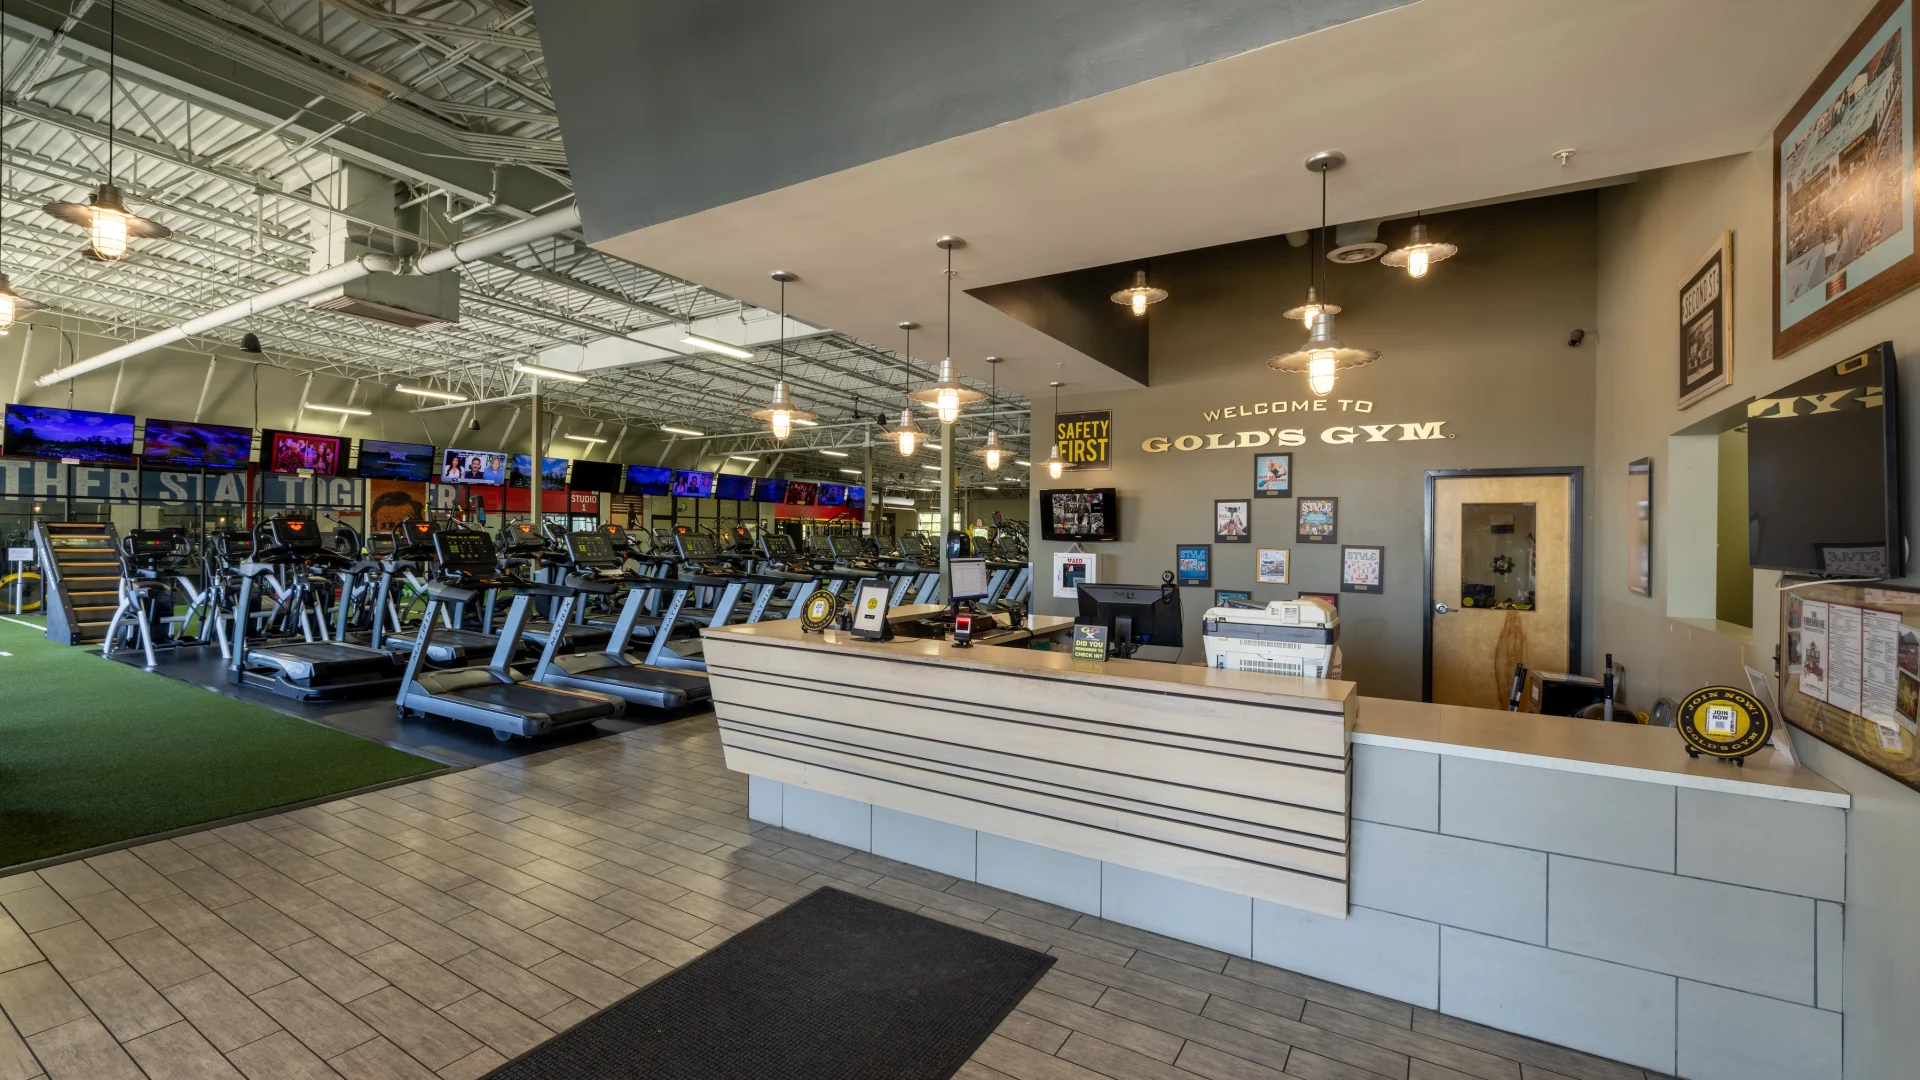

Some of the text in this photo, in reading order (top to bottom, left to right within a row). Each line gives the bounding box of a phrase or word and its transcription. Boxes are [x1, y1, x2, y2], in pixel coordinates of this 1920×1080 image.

[1684, 269, 1716, 319] SECOND ST
[1203, 399, 1374, 422] WELCOME TO
[1057, 420, 1109, 440] SAFETY
[1141, 421, 1448, 453] GOLD'S GYM
[1058, 438, 1108, 463] FIRST
[571, 494, 597, 503] STUDIO
[581, 503, 586, 512] 1
[1302, 502, 1332, 512] STYLE
[1180, 549, 1206, 560] STYLE
[1347, 551, 1377, 561] STYLE
[752, 587, 773, 623] MATRIX
[1113, 591, 1136, 600] DELL
[551, 601, 571, 646] MATRIX
[664, 593, 684, 632] MATRIX
[413, 611, 432, 661] MATRIX
[1688, 692, 1759, 715] JOIN NOW!
[1686, 726, 1758, 751] GOLD'S GYM
